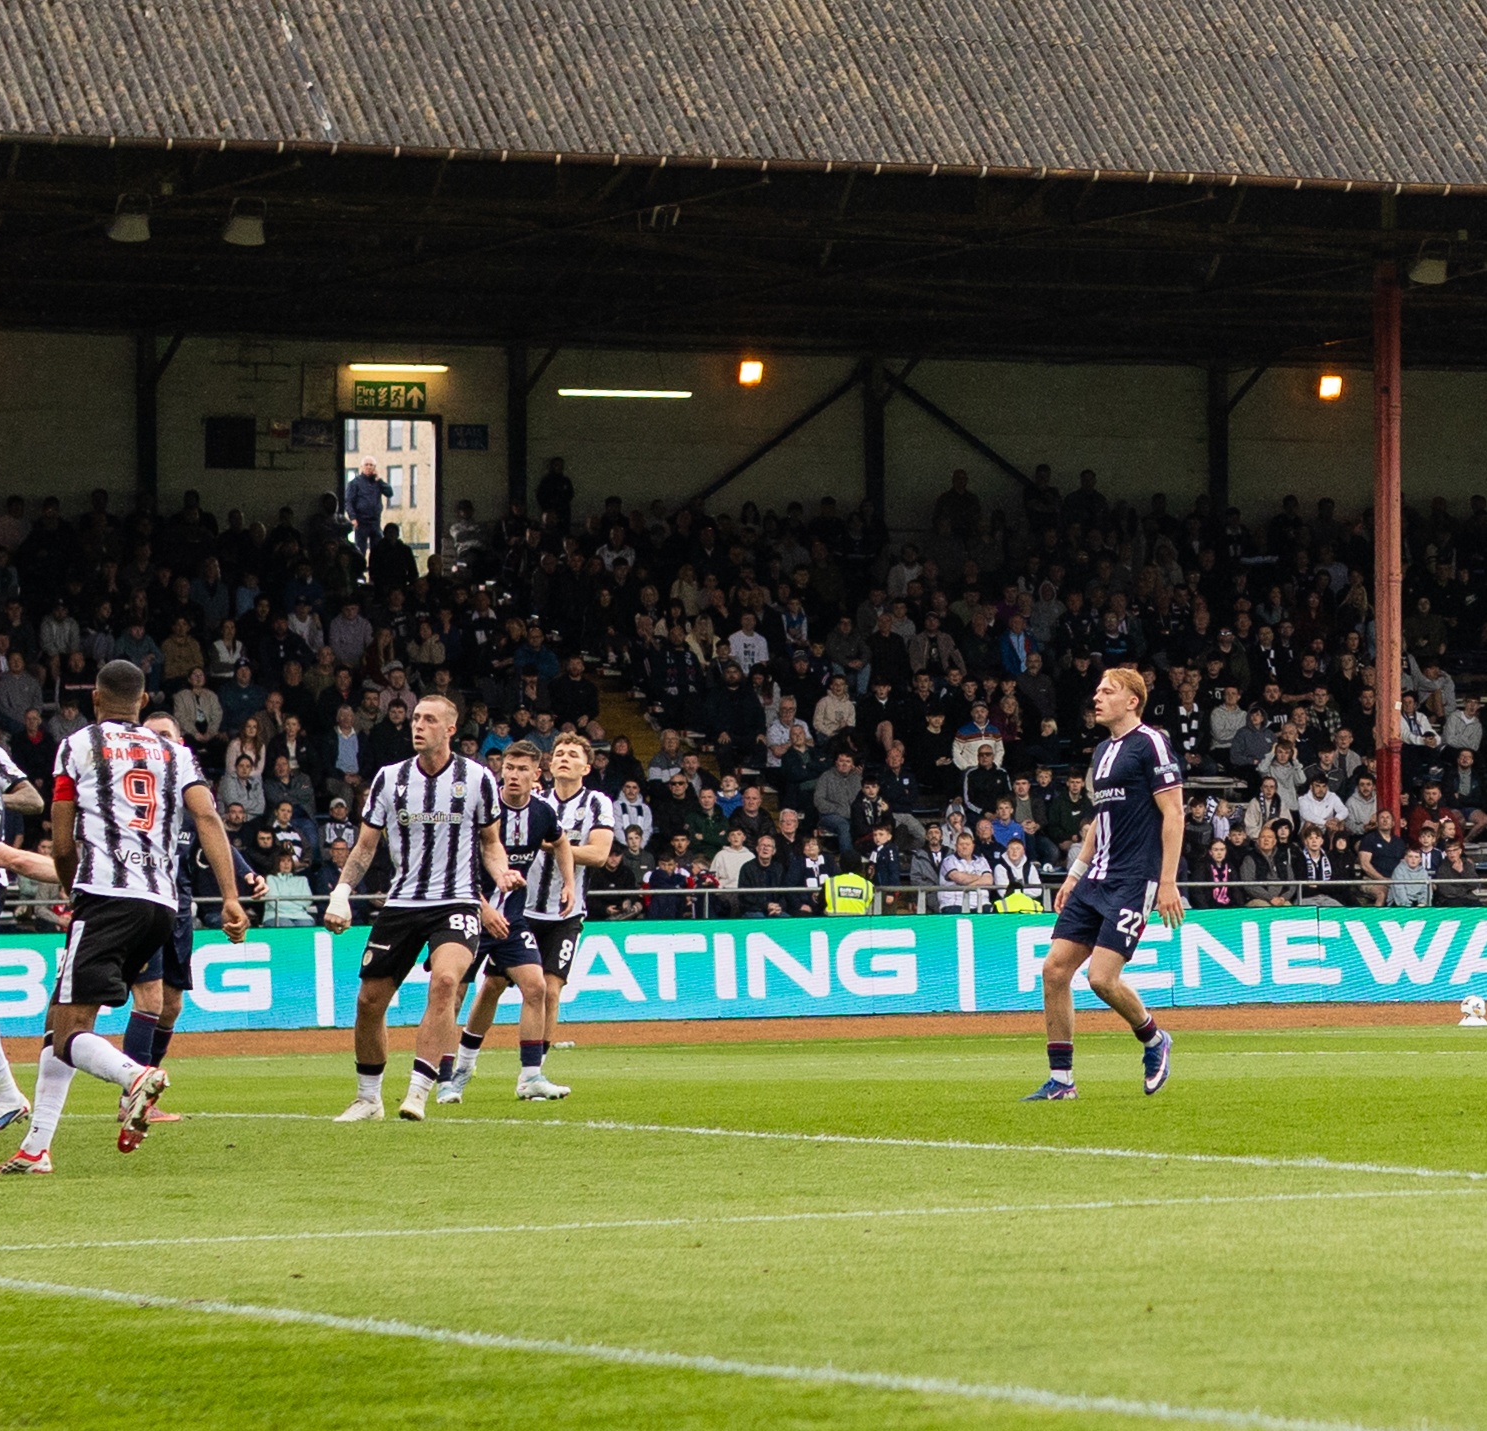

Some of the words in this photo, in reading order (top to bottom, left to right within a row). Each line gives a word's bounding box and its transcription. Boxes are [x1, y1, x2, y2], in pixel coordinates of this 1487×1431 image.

[356, 385, 375, 396] Fire
[356, 396, 375, 406] Exit
[123, 768, 157, 832] 9
[448, 913, 478, 935] 88
[1116, 908, 1143, 937] 22
[559, 938, 574, 961] 8
